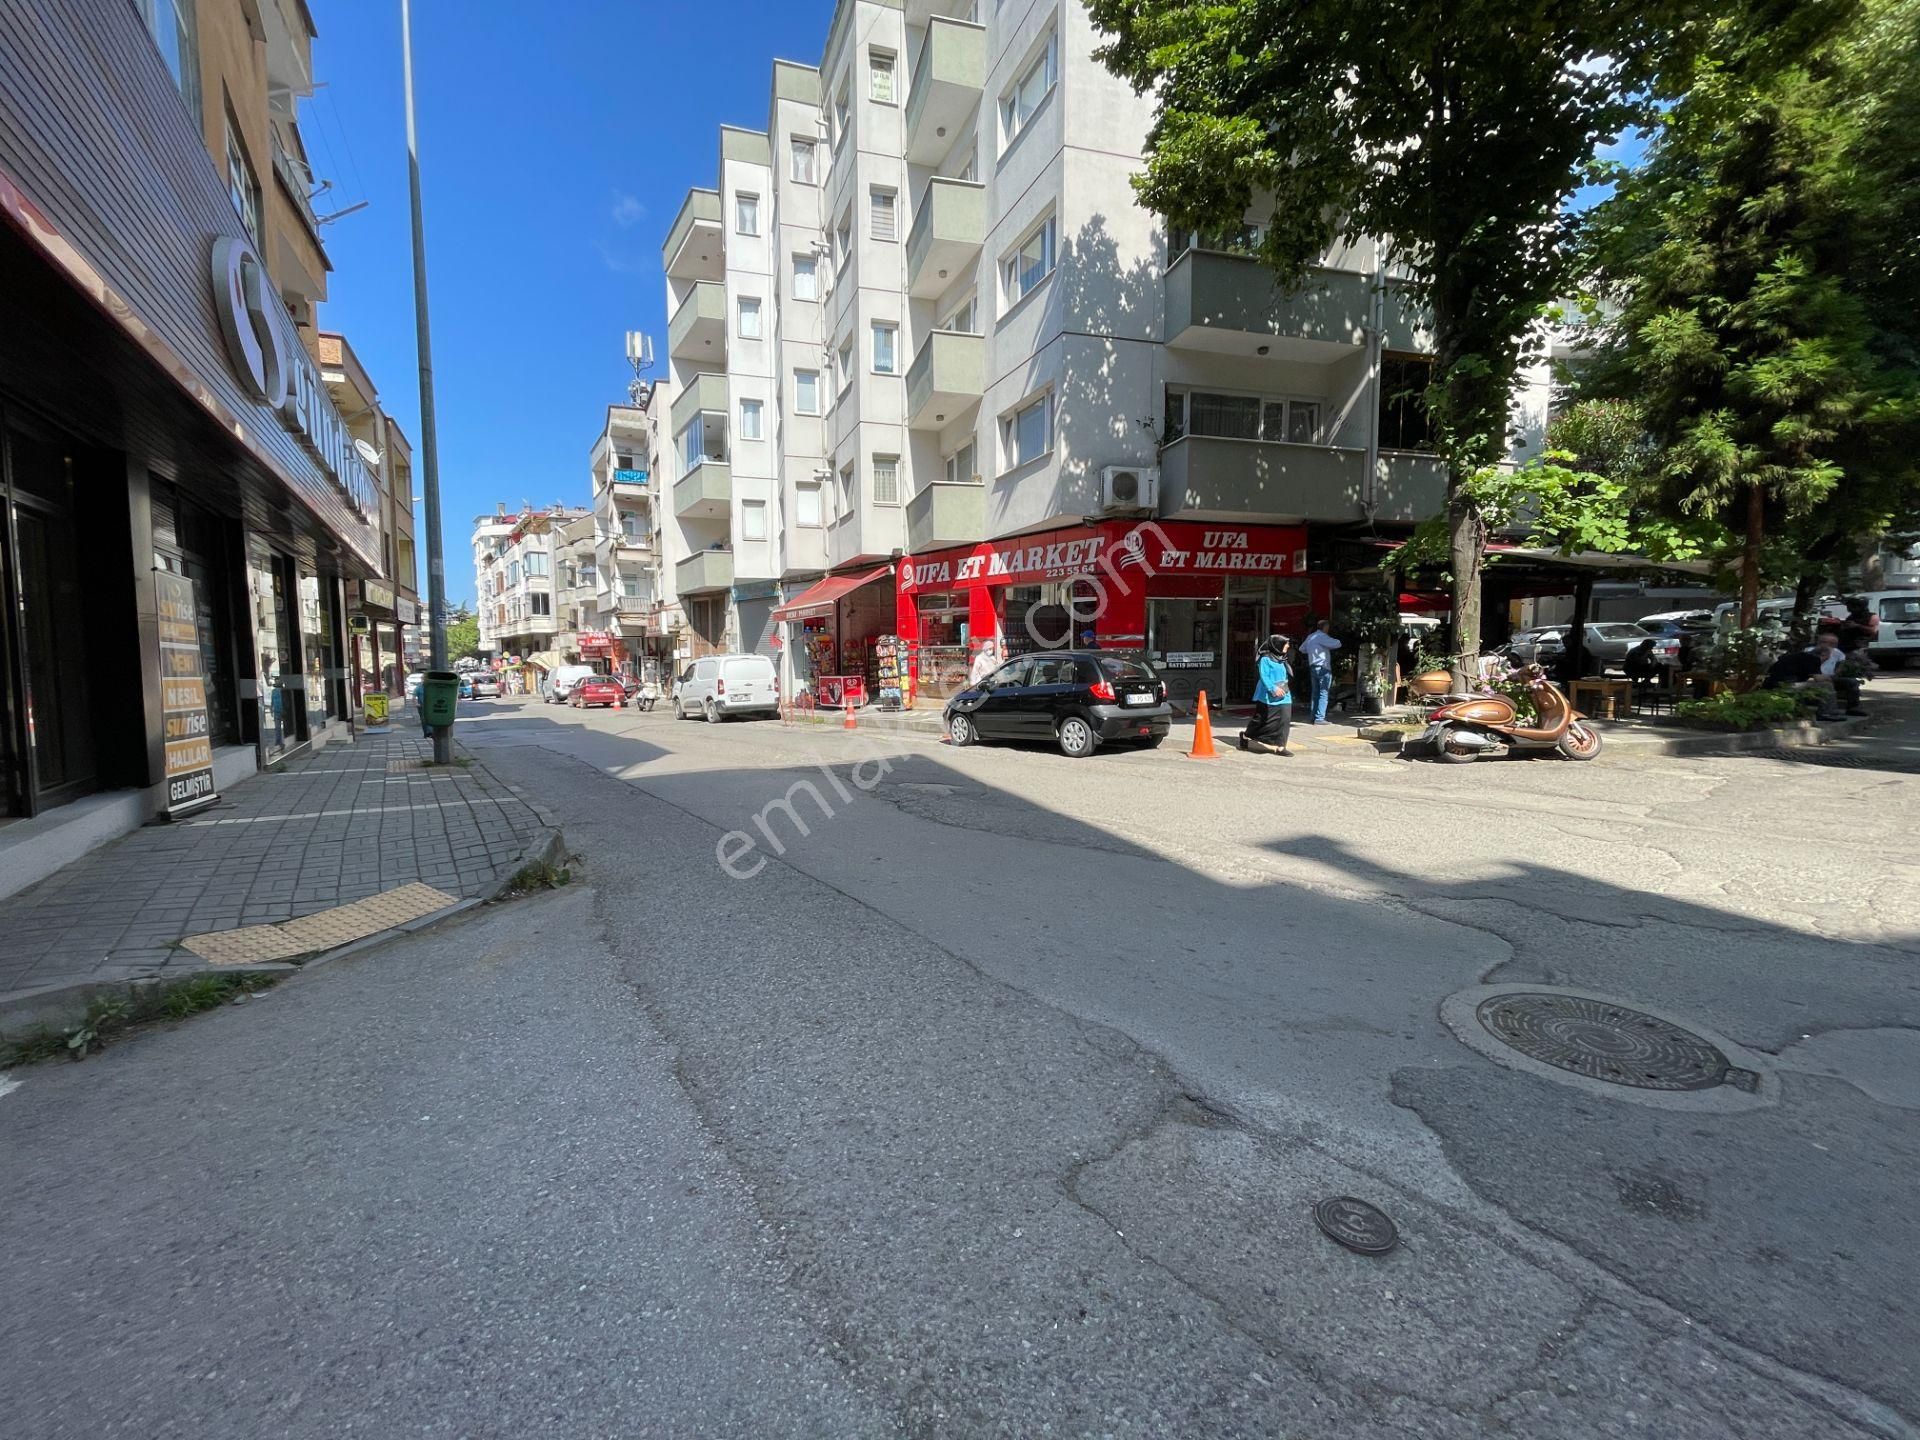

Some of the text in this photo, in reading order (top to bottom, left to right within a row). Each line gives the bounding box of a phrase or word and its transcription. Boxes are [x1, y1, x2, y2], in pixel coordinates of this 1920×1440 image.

[1203, 531, 1248, 548] UFA
[915, 537, 1104, 586] UFA ET MARKET
[1159, 550, 1287, 570] ET MARKET
[1046, 564, 1095, 577] 223 55 64
[166, 712, 206, 738] sunrise
